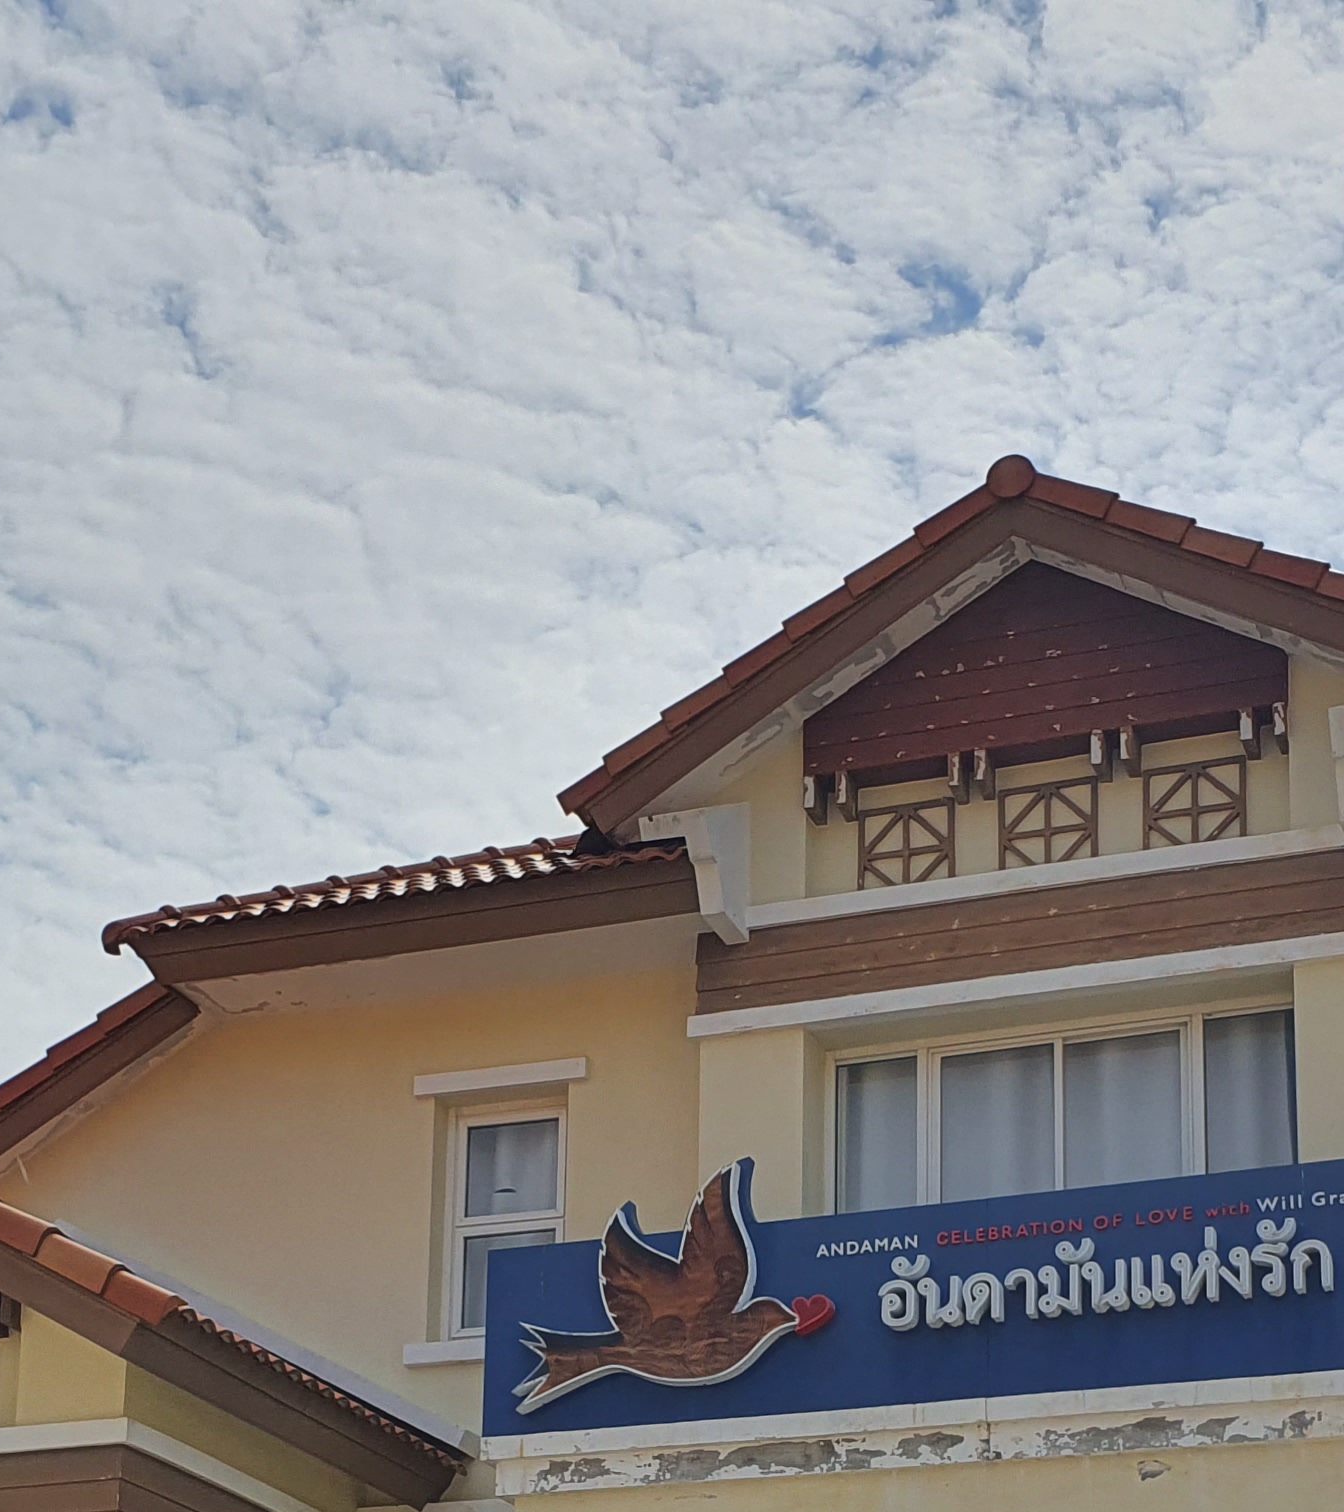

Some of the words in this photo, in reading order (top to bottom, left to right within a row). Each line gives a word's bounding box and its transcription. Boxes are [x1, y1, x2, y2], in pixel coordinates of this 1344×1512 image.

[816, 1234, 919, 1258] ANDAMAN
[936, 1217, 1084, 1246] CELEBRATION
[1093, 1214, 1123, 1230] OF
[1135, 1206, 1194, 1226] LOVE
[1256, 1193, 1303, 1213] Will
[877, 1217, 1334, 1331] อันดามันแห่งรัก
